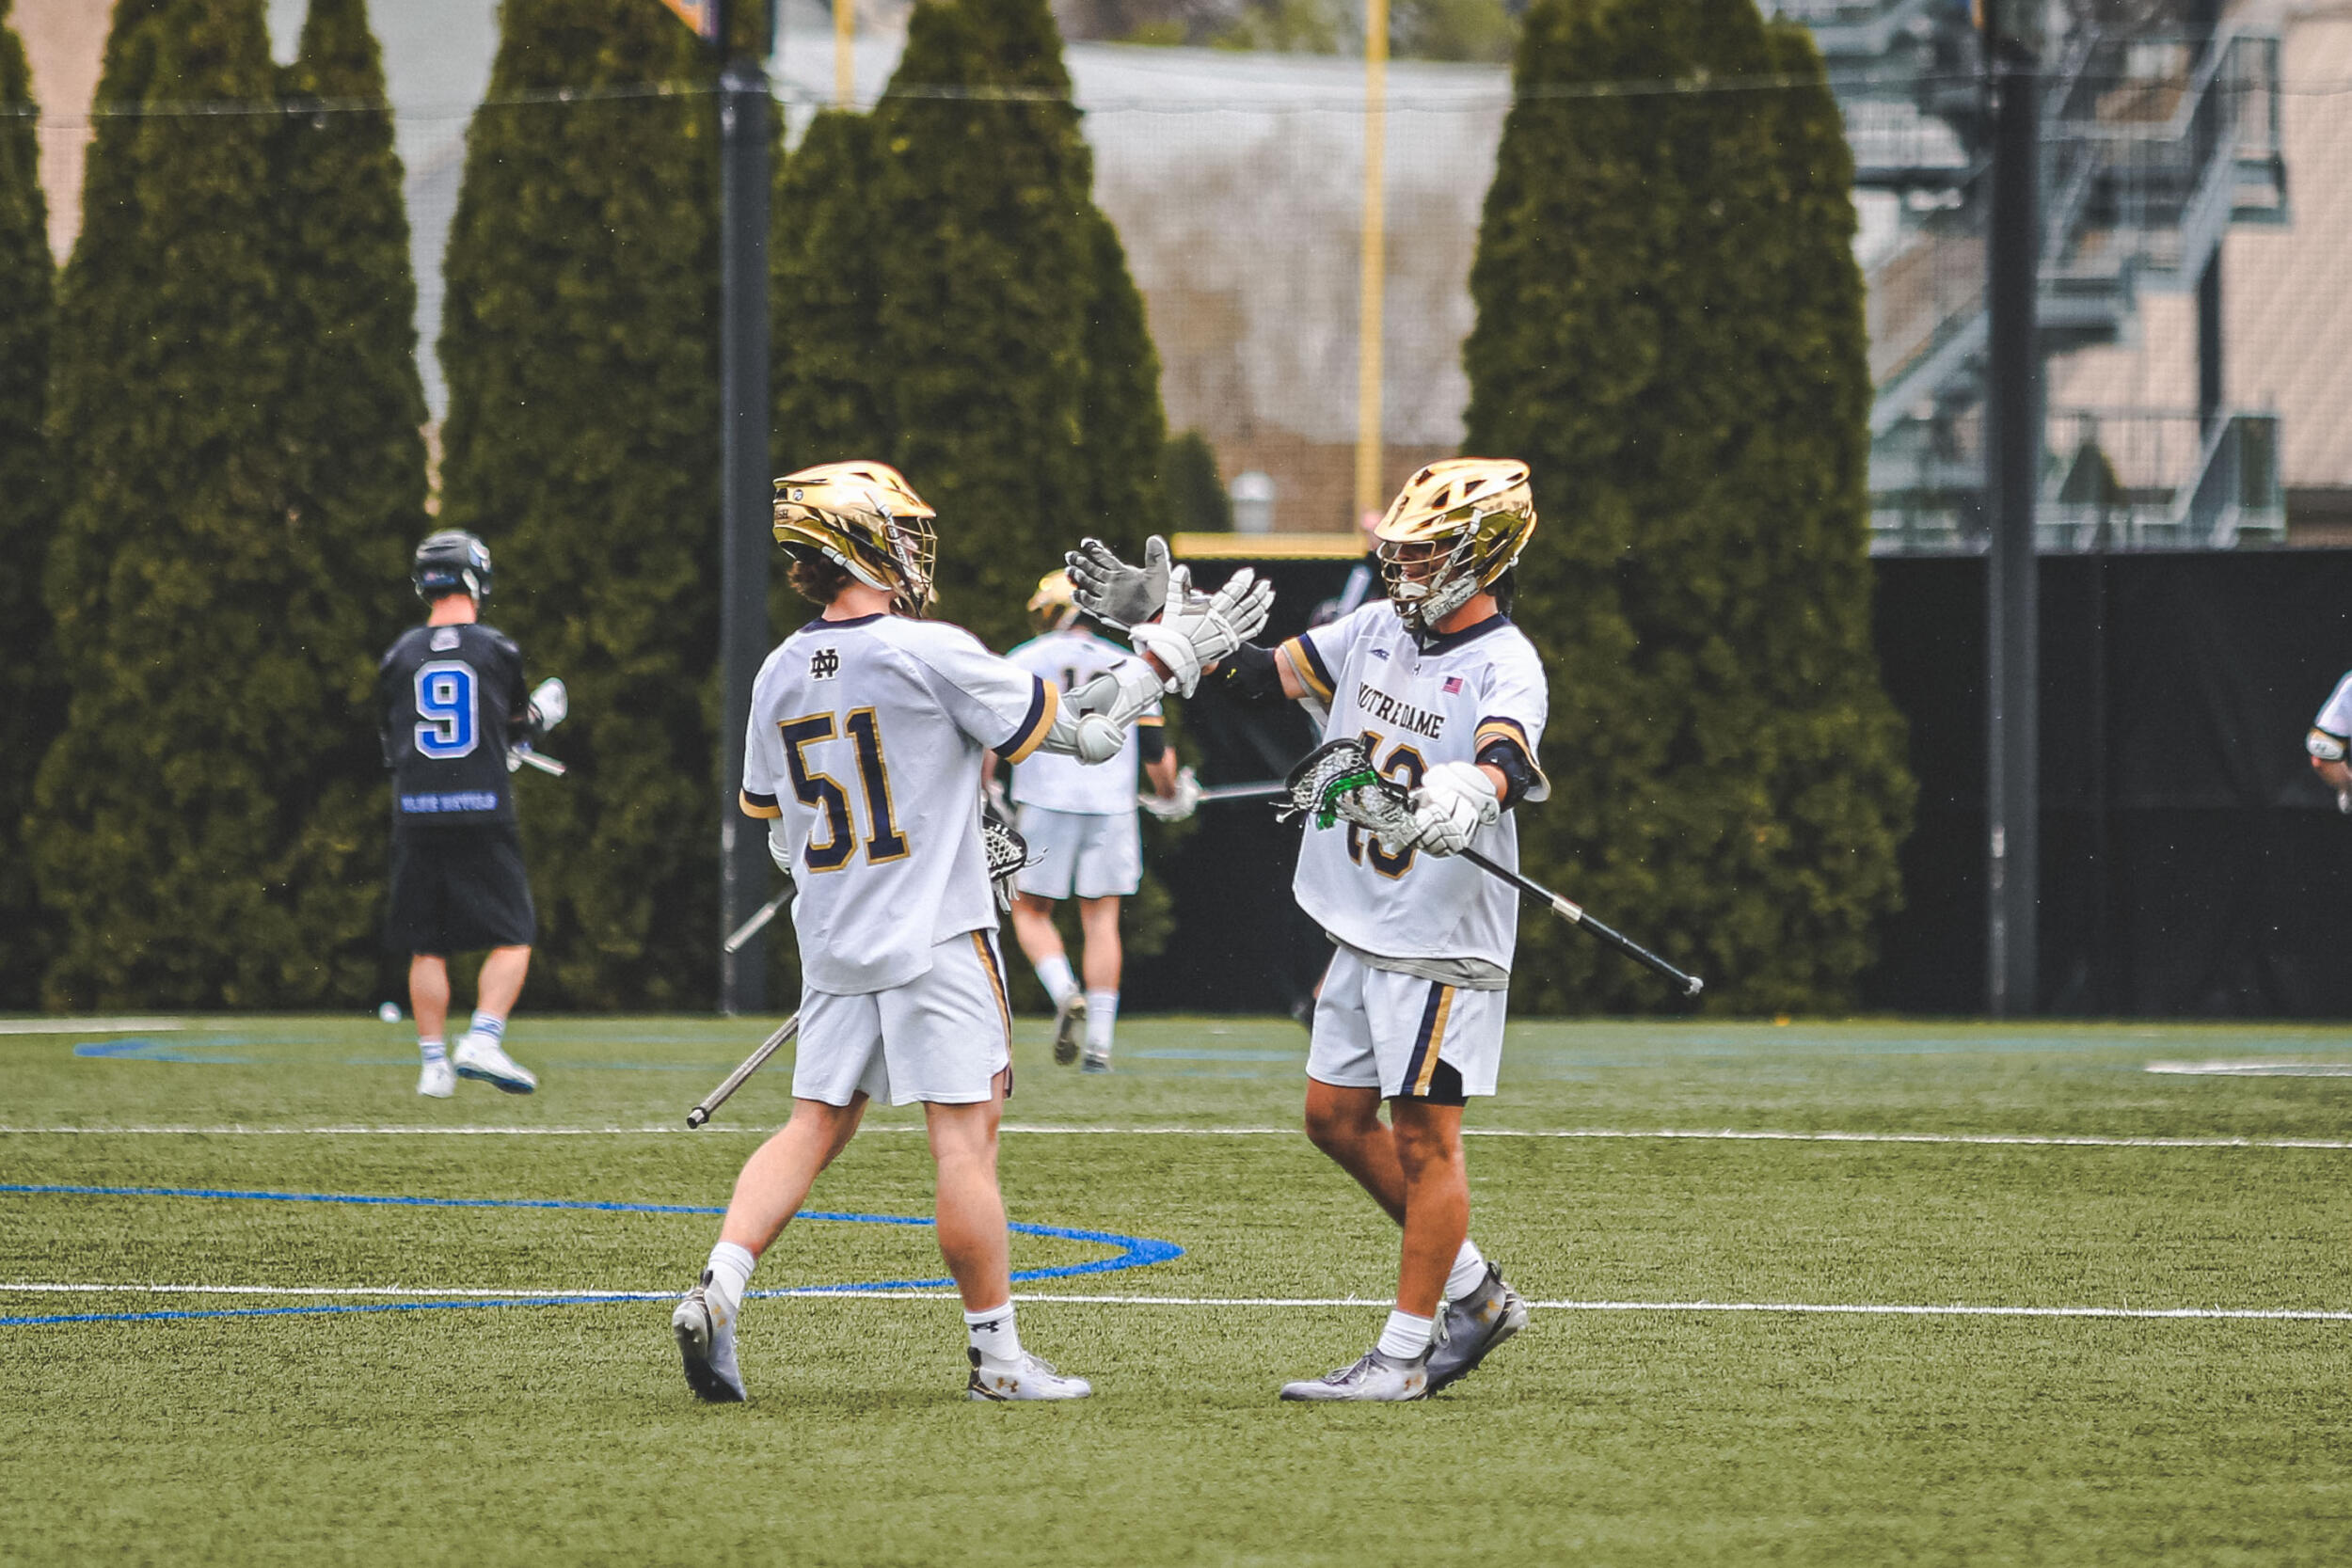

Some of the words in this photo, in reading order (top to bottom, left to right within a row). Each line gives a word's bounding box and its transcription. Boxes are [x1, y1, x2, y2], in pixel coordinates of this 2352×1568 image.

[415, 660, 479, 759] 9
[1358, 681, 1401, 725] NOTRE
[1399, 705, 1445, 739] DAME
[779, 706, 909, 873] 51
